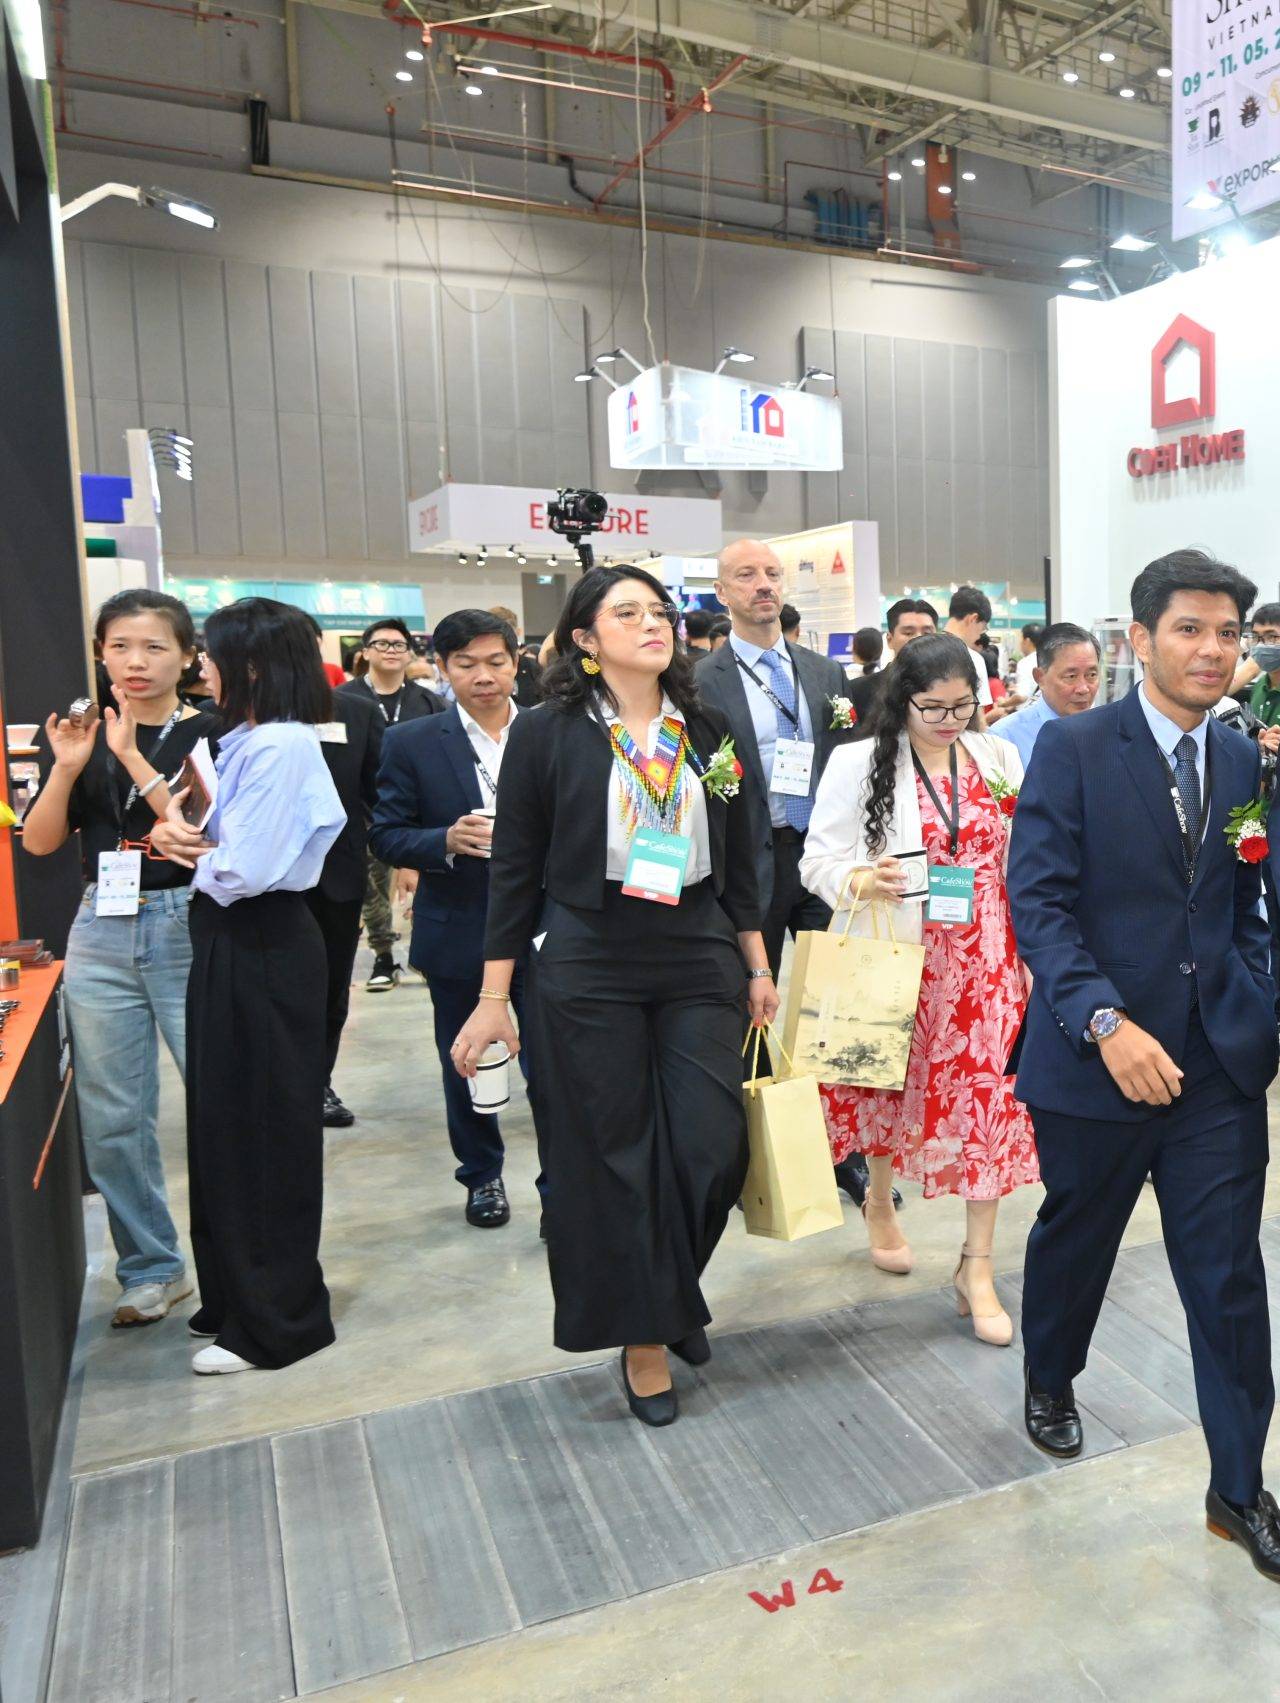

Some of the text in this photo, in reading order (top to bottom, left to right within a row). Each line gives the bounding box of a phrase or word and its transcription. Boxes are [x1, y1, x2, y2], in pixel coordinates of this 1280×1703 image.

[1182, 72, 1202, 97] 09
[1243, 37, 1269, 65] 05.
[1180, 428, 1246, 469] HOME
